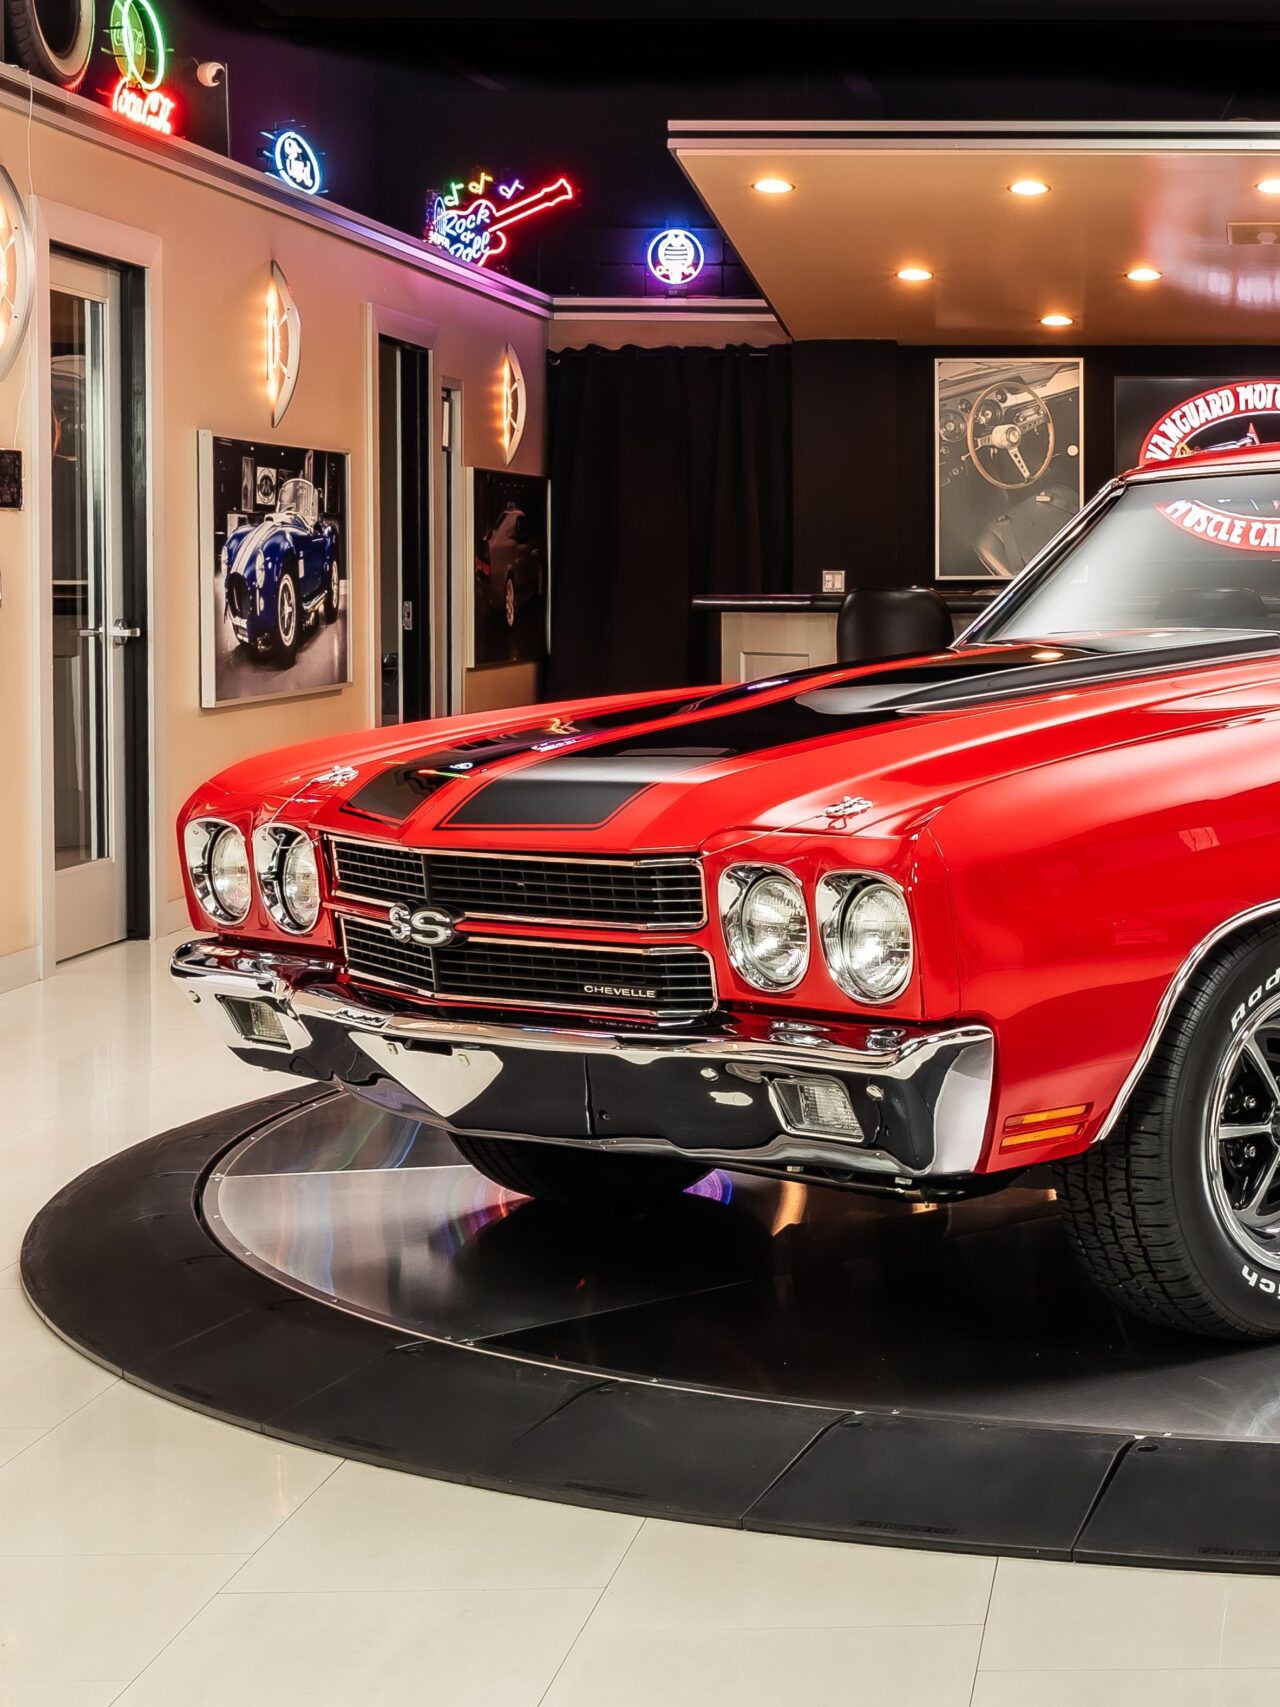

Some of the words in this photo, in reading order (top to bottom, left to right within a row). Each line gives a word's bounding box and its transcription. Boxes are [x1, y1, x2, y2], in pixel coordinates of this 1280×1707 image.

[443, 202, 491, 236] Rock
[1144, 388, 1235, 461] VANGUARD
[1164, 499, 1247, 544] MUSCLE
[389, 906, 452, 945] SS
[583, 984, 656, 998] CHEVELLE
